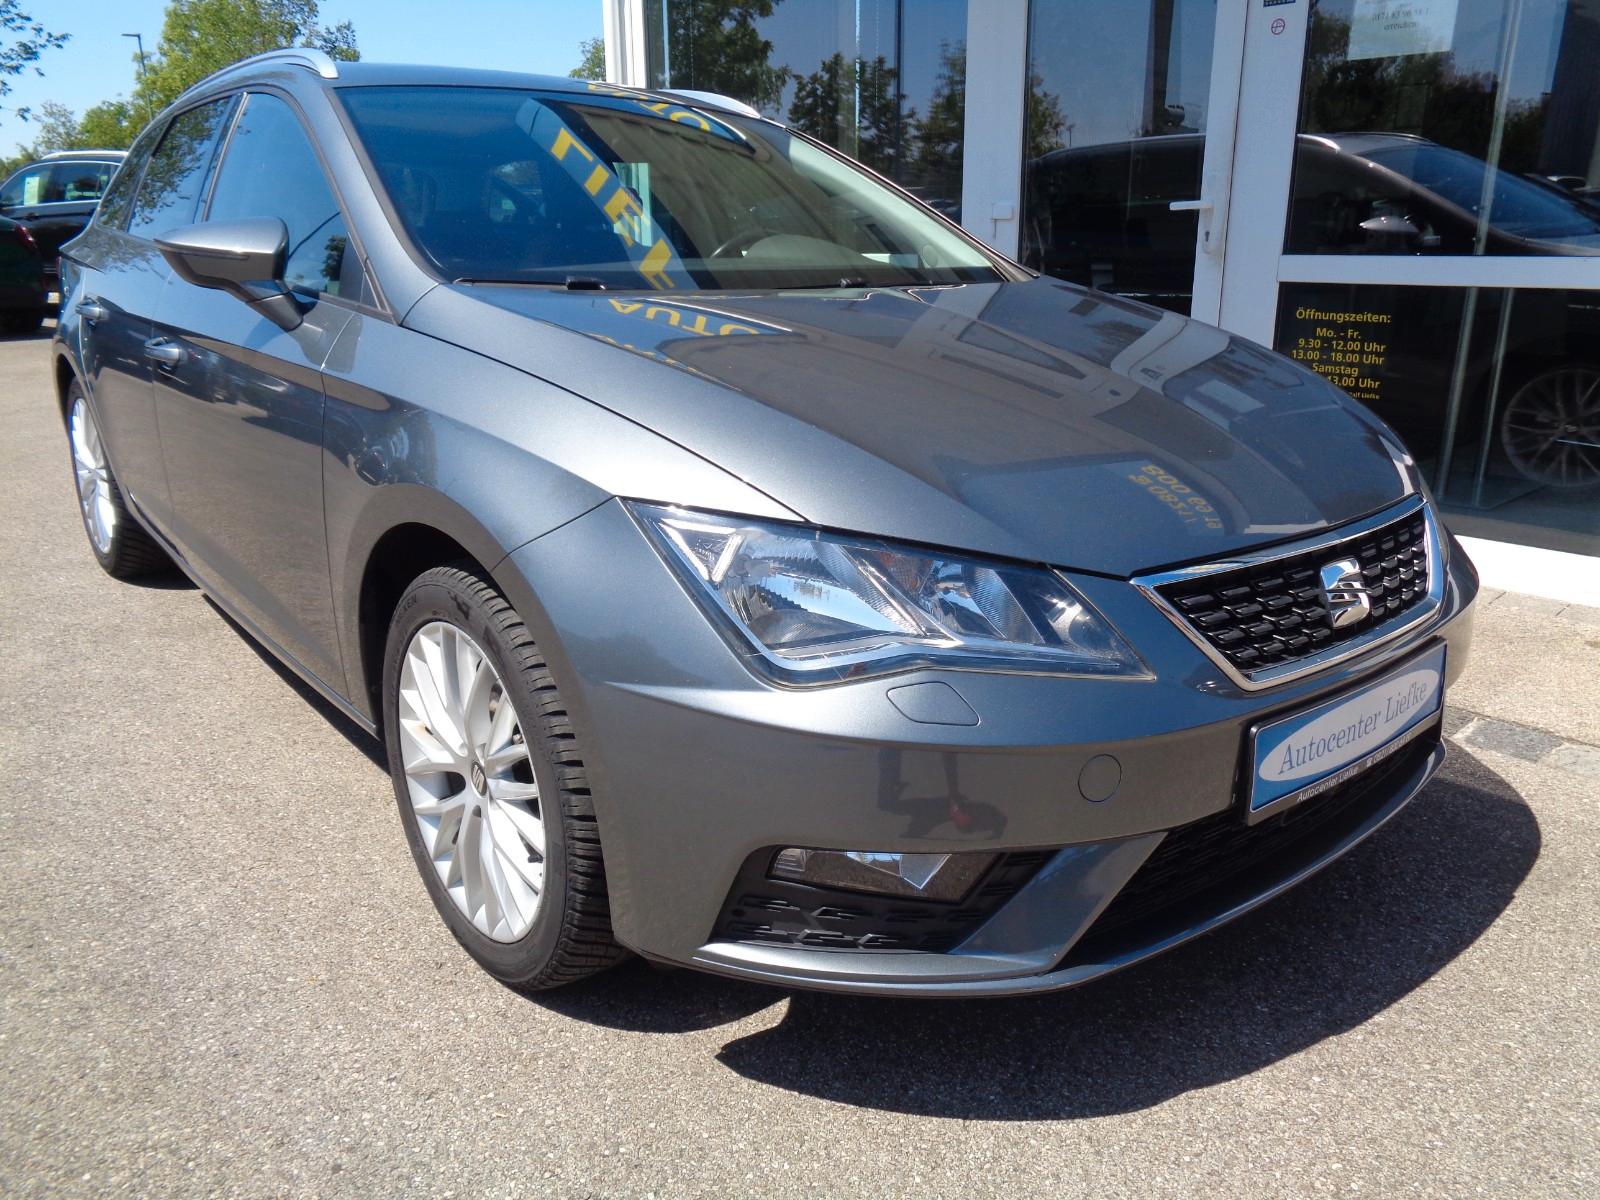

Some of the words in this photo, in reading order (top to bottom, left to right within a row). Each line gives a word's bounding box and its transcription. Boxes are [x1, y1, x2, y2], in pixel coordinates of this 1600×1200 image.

[1296, 306, 1392, 323] Öffnungszeiten:
[1316, 327, 1337, 338] Mo.
[1347, 329, 1361, 339] Fr.
[1298, 338, 1321, 349] 9.30
[1332, 340, 1361, 351] 12.00
[1364, 342, 1386, 353] Uhr
[1292, 349, 1320, 360] 13.00
[1331, 352, 1359, 363] 18.00
[1363, 354, 1385, 365] Uhr
[1312, 362, 1359, 377] Samstag
[1359, 378, 1381, 389] Uhr
[1278, 711, 1381, 775] Autocenter
[1384, 681, 1428, 723] Liefke
[1297, 777, 1338, 802] Autocenter
